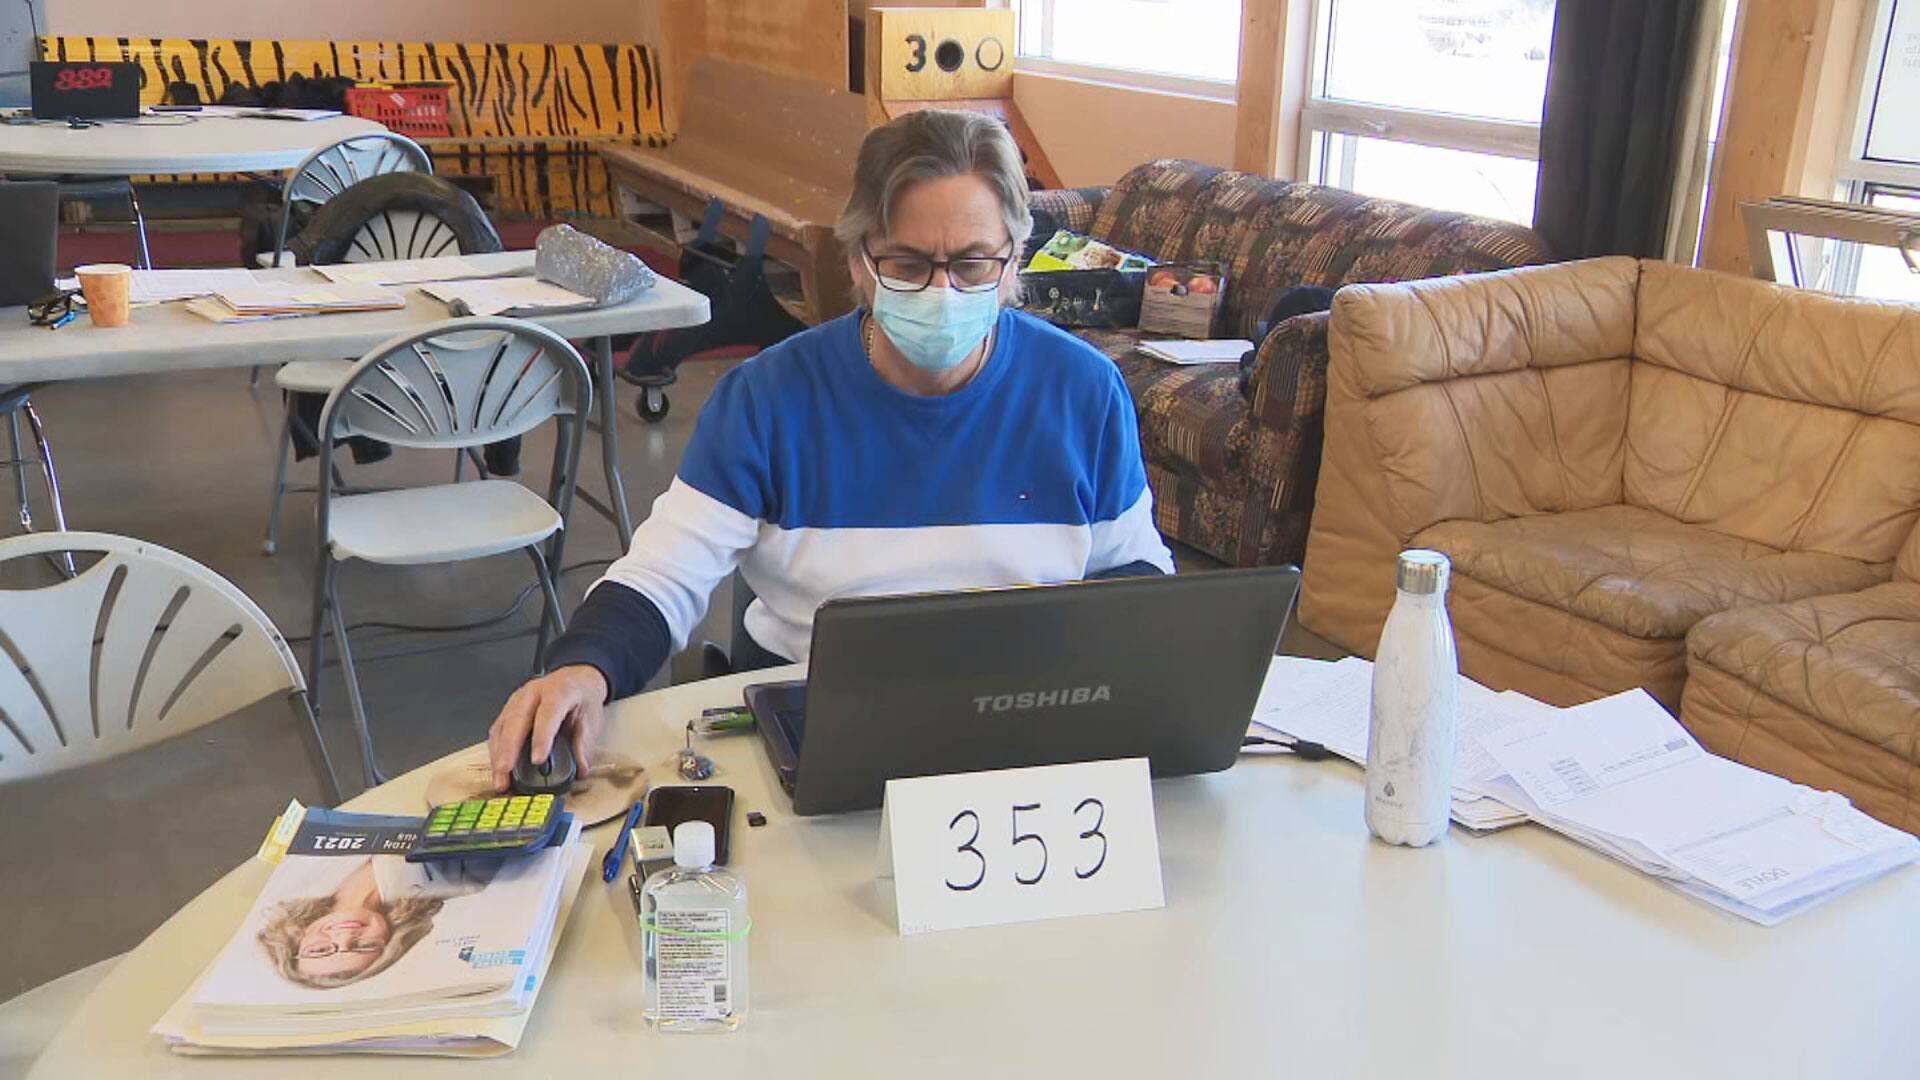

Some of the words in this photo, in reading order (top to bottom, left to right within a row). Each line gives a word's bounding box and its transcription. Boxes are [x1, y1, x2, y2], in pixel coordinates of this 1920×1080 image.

[972, 685, 1111, 713] TOSHIBA
[313, 835, 366, 849] 2021
[944, 797, 1108, 891] 353
